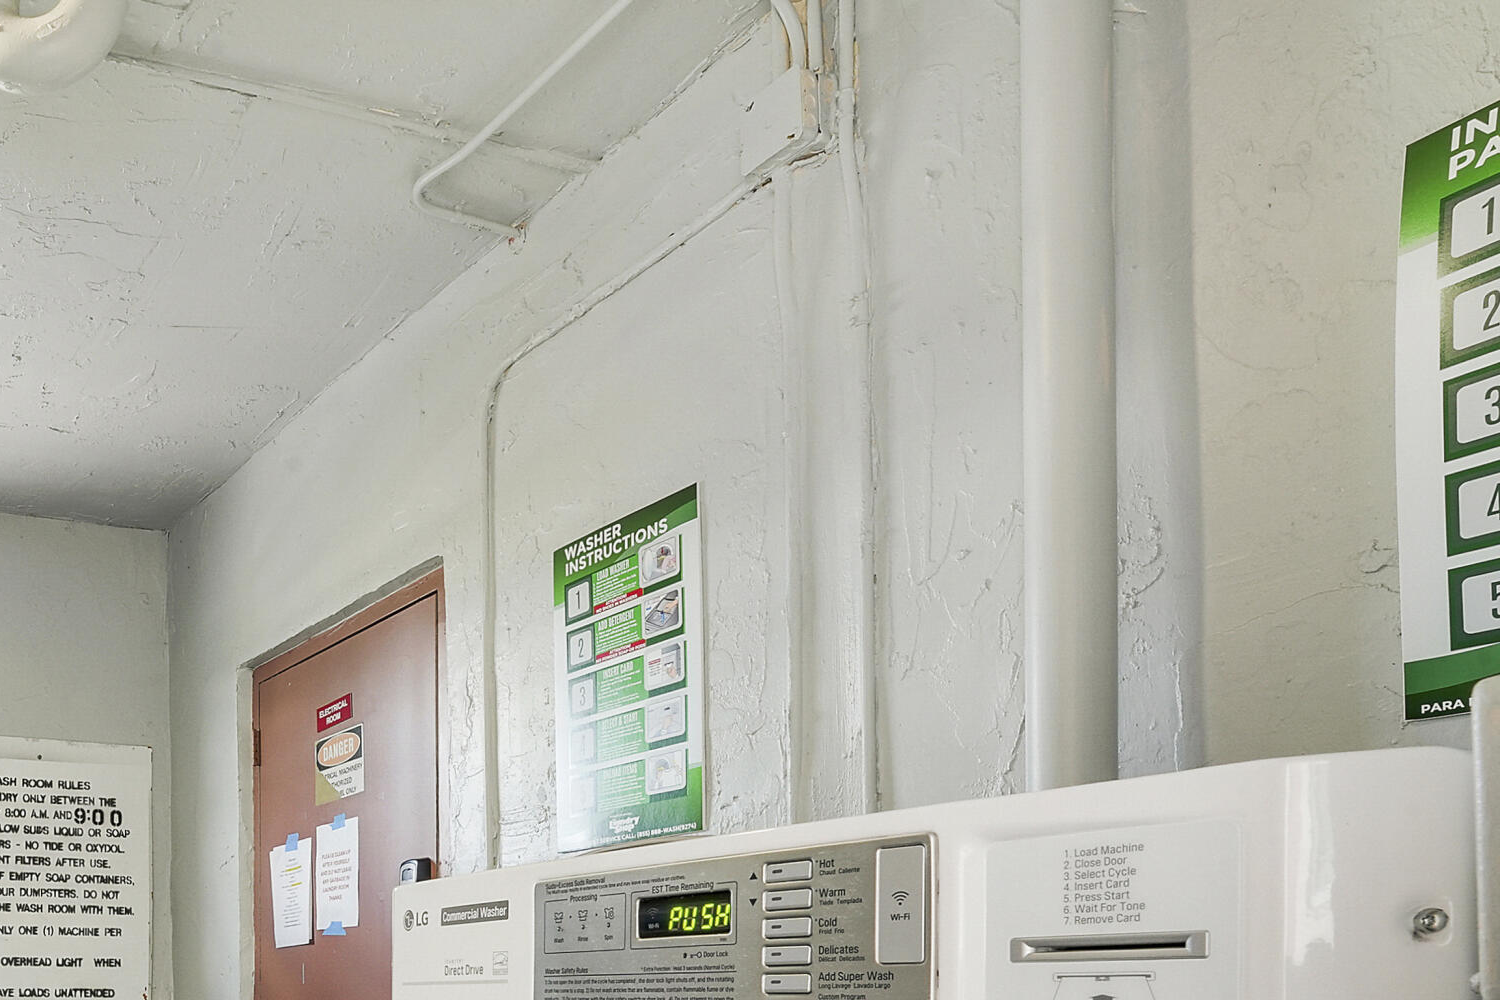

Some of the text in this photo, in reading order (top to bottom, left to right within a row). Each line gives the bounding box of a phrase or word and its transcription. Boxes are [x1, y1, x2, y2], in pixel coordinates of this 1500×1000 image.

[1482, 196, 1495, 236] 1
[1483, 290, 1500, 331] 2
[1484, 386, 1500, 425] 3
[565, 524, 621, 561] WASHER
[566, 518, 668, 576] INSTRUCTIONS
[576, 590, 581, 609] 1
[578, 638, 584, 658] 2
[580, 687, 586, 705] 3
[319, 699, 348, 719] ELECTRICAL
[1421, 699, 1465, 714] PARA
[326, 712, 341, 725] ROOM
[323, 738, 354, 761] DANGER
[22, 778, 52, 788] ROOM
[58, 780, 91, 790] RULES
[0, 792, 18, 802] DRY
[23, 794, 45, 803] ONLY
[50, 795, 95, 806] BETWEEN
[99, 798, 116, 807] THE
[5, 808, 26, 817] 8:00
[31, 809, 49, 819] A.M.
[53, 811, 72, 820] AND
[24, 826, 49, 835] SUDS
[54, 827, 83, 837] LIQUID
[88, 829, 101, 837] OR
[106, 829, 130, 838] SOAP
[25, 842, 38, 850] NO
[44, 843, 64, 851] TIDE
[68, 843, 82, 852] OR
[1075, 843, 1144, 857] Load Machine
[15, 856, 51, 866] FILTERS
[56, 858, 85, 867] AFTER
[90, 859, 111, 868] USE.
[820, 859, 834, 868] Hot
[1075, 856, 1126, 868] Close Door
[9, 872, 40, 881] EMPTY
[46, 873, 70, 882] SOAP
[75, 875, 135, 885] CONTAINERS,
[1074, 867, 1136, 880] Select Cycle
[652, 886, 663, 894] EST
[681, 882, 714, 891] Remaining
[1074, 878, 1130, 891] Insert Card
[20, 888, 78, 899] DUMPSTERS.
[84, 890, 97, 899] DO
[102, 891, 120, 899] NOT
[570, 894, 597, 902] Processing
[819, 888, 846, 897] Warm
[1074, 891, 1130, 902] Press Start
[16, 903, 42, 913] WASH
[48, 904, 76, 914] ROOM
[80, 905, 103, 915] WITH
[108, 906, 134, 916] THEM.
[1075, 902, 1145, 913] Wait For Tone
[443, 909, 479, 922] Commercial
[480, 906, 507, 918] Washer
[668, 904, 730, 930] PUSH
[1075, 913, 1140, 924] Remove Card
[819, 917, 837, 927] Cold
[19, 926, 38, 935] ONE
[43, 926, 53, 936] (1)
[58, 927, 99, 936] MACHINE
[105, 928, 122, 936] PER
[819, 946, 859, 954] Delicates
[1, 958, 51, 966] OVERHEAD
[56, 958, 82, 967] LIGHT
[94, 958, 121, 967] WHEN
[445, 965, 483, 975] Direct Drive
[819, 972, 894, 982] Add Super Wash
[19, 988, 50, 997] LOADS
[55, 989, 115, 997] UNATTENDED
